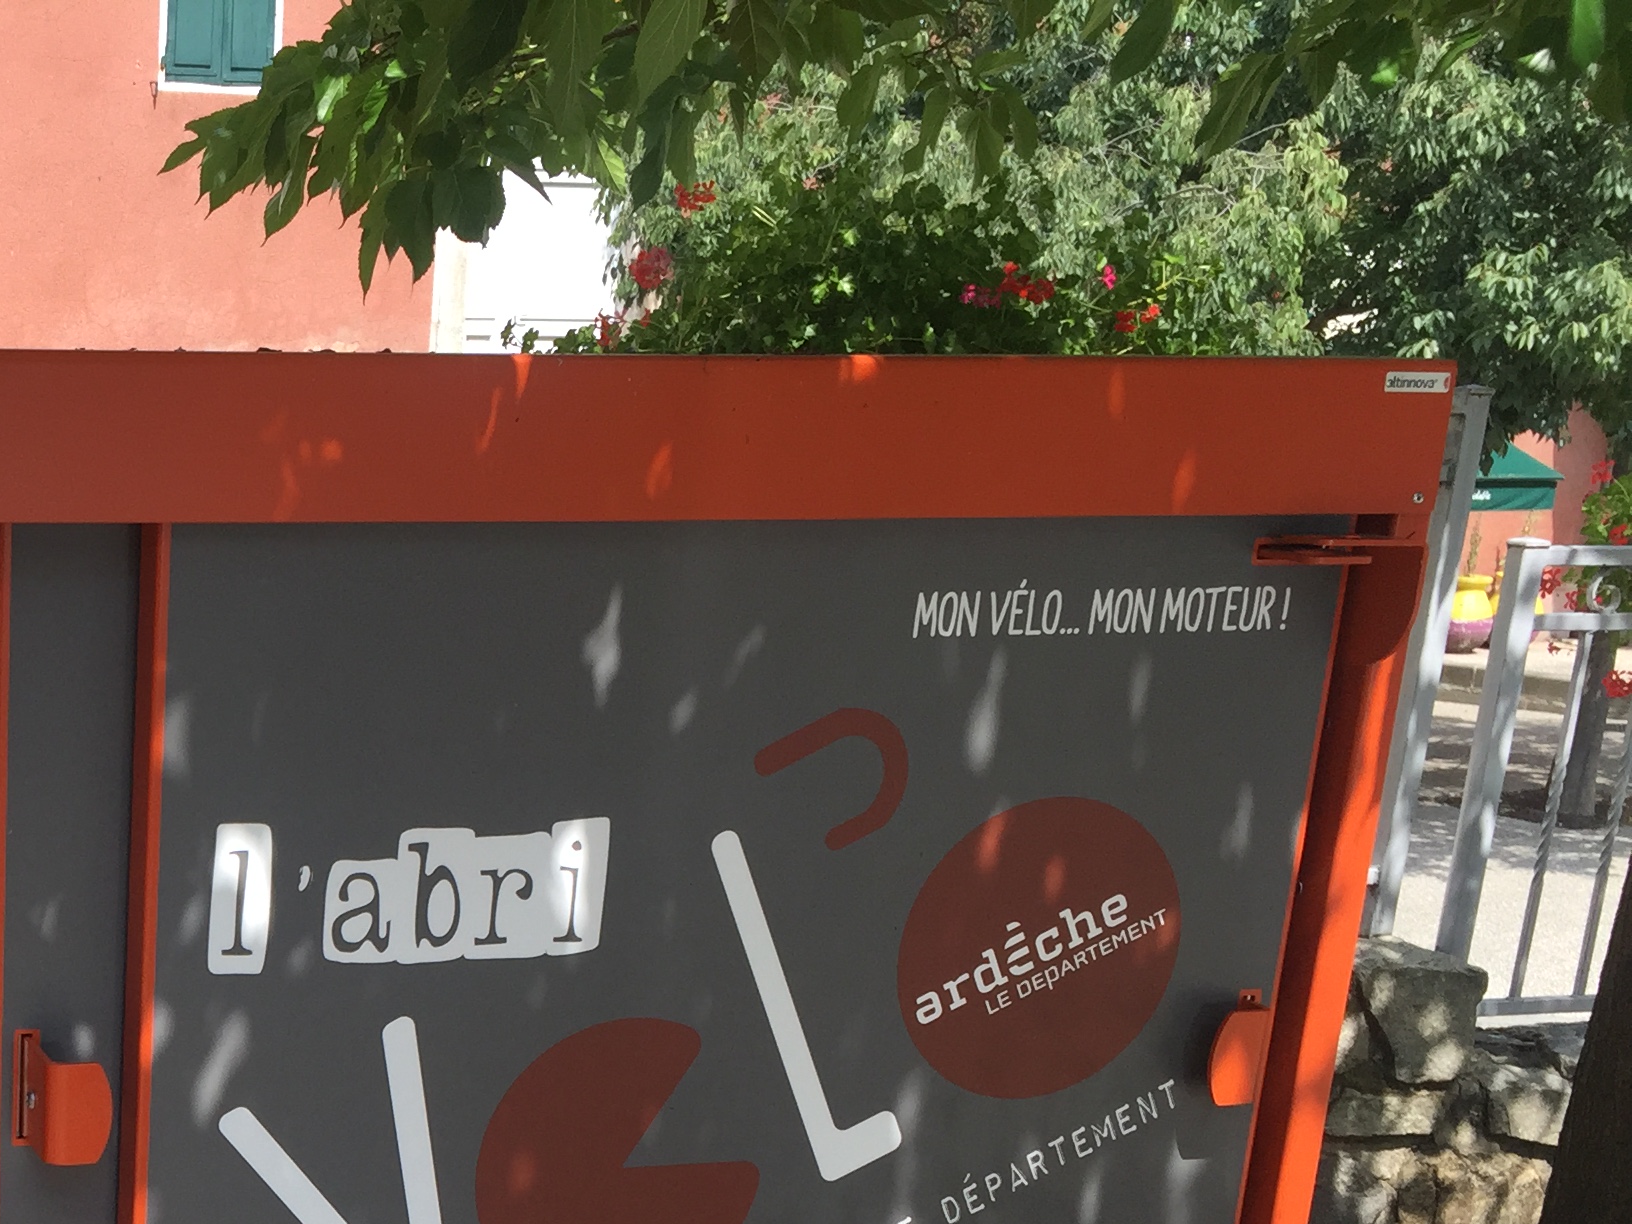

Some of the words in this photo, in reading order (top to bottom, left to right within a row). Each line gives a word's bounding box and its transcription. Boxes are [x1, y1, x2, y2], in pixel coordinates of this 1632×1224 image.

[912, 590, 981, 639] MON
[1088, 587, 1156, 636] MON
[214, 828, 596, 966] l'abri
[984, 989, 1012, 1015] LE
[940, 1078, 1177, 1224] DÉPARTEMENT
